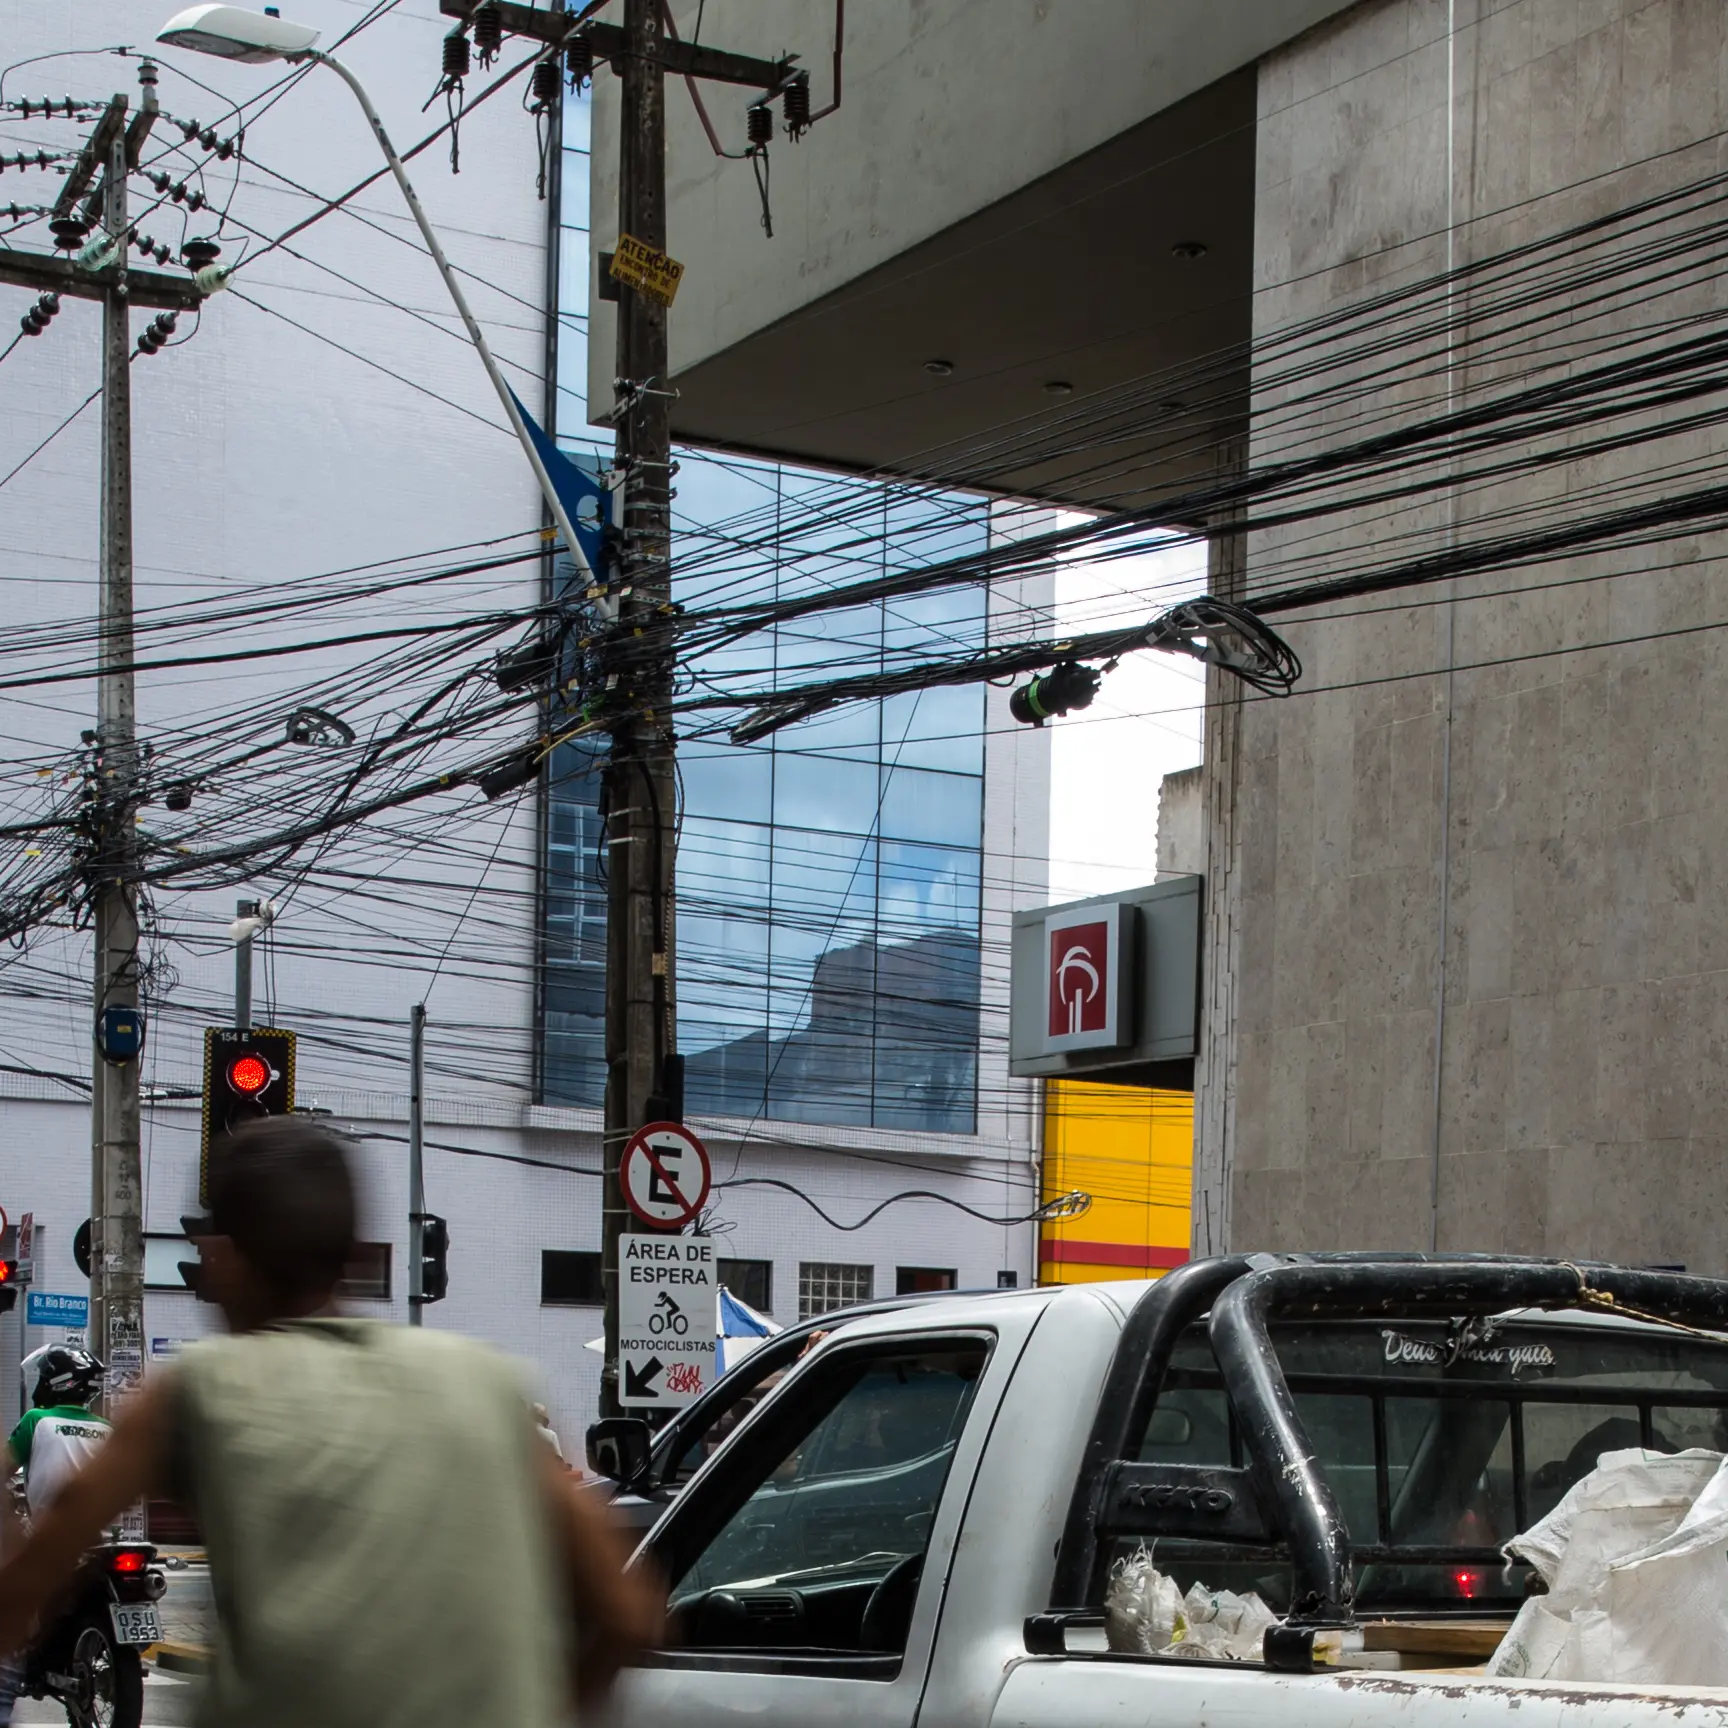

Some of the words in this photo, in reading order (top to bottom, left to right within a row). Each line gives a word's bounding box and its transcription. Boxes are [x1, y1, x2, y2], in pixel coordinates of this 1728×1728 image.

[221, 1032, 238, 1042] 154
[648, 1144, 683, 1205] E
[625, 1239, 680, 1261] ÁREA
[686, 1244, 712, 1263] DE
[630, 1266, 709, 1285] ESPERA
[33, 1295, 45, 1309] Br.
[45, 1296, 58, 1309] Rio
[59, 1298, 87, 1311] Branco
[620, 1339, 716, 1352] MOTOCICLISTAS
[1381, 1328, 1438, 1362] Deus
[122, 1626, 159, 1642] 1953
